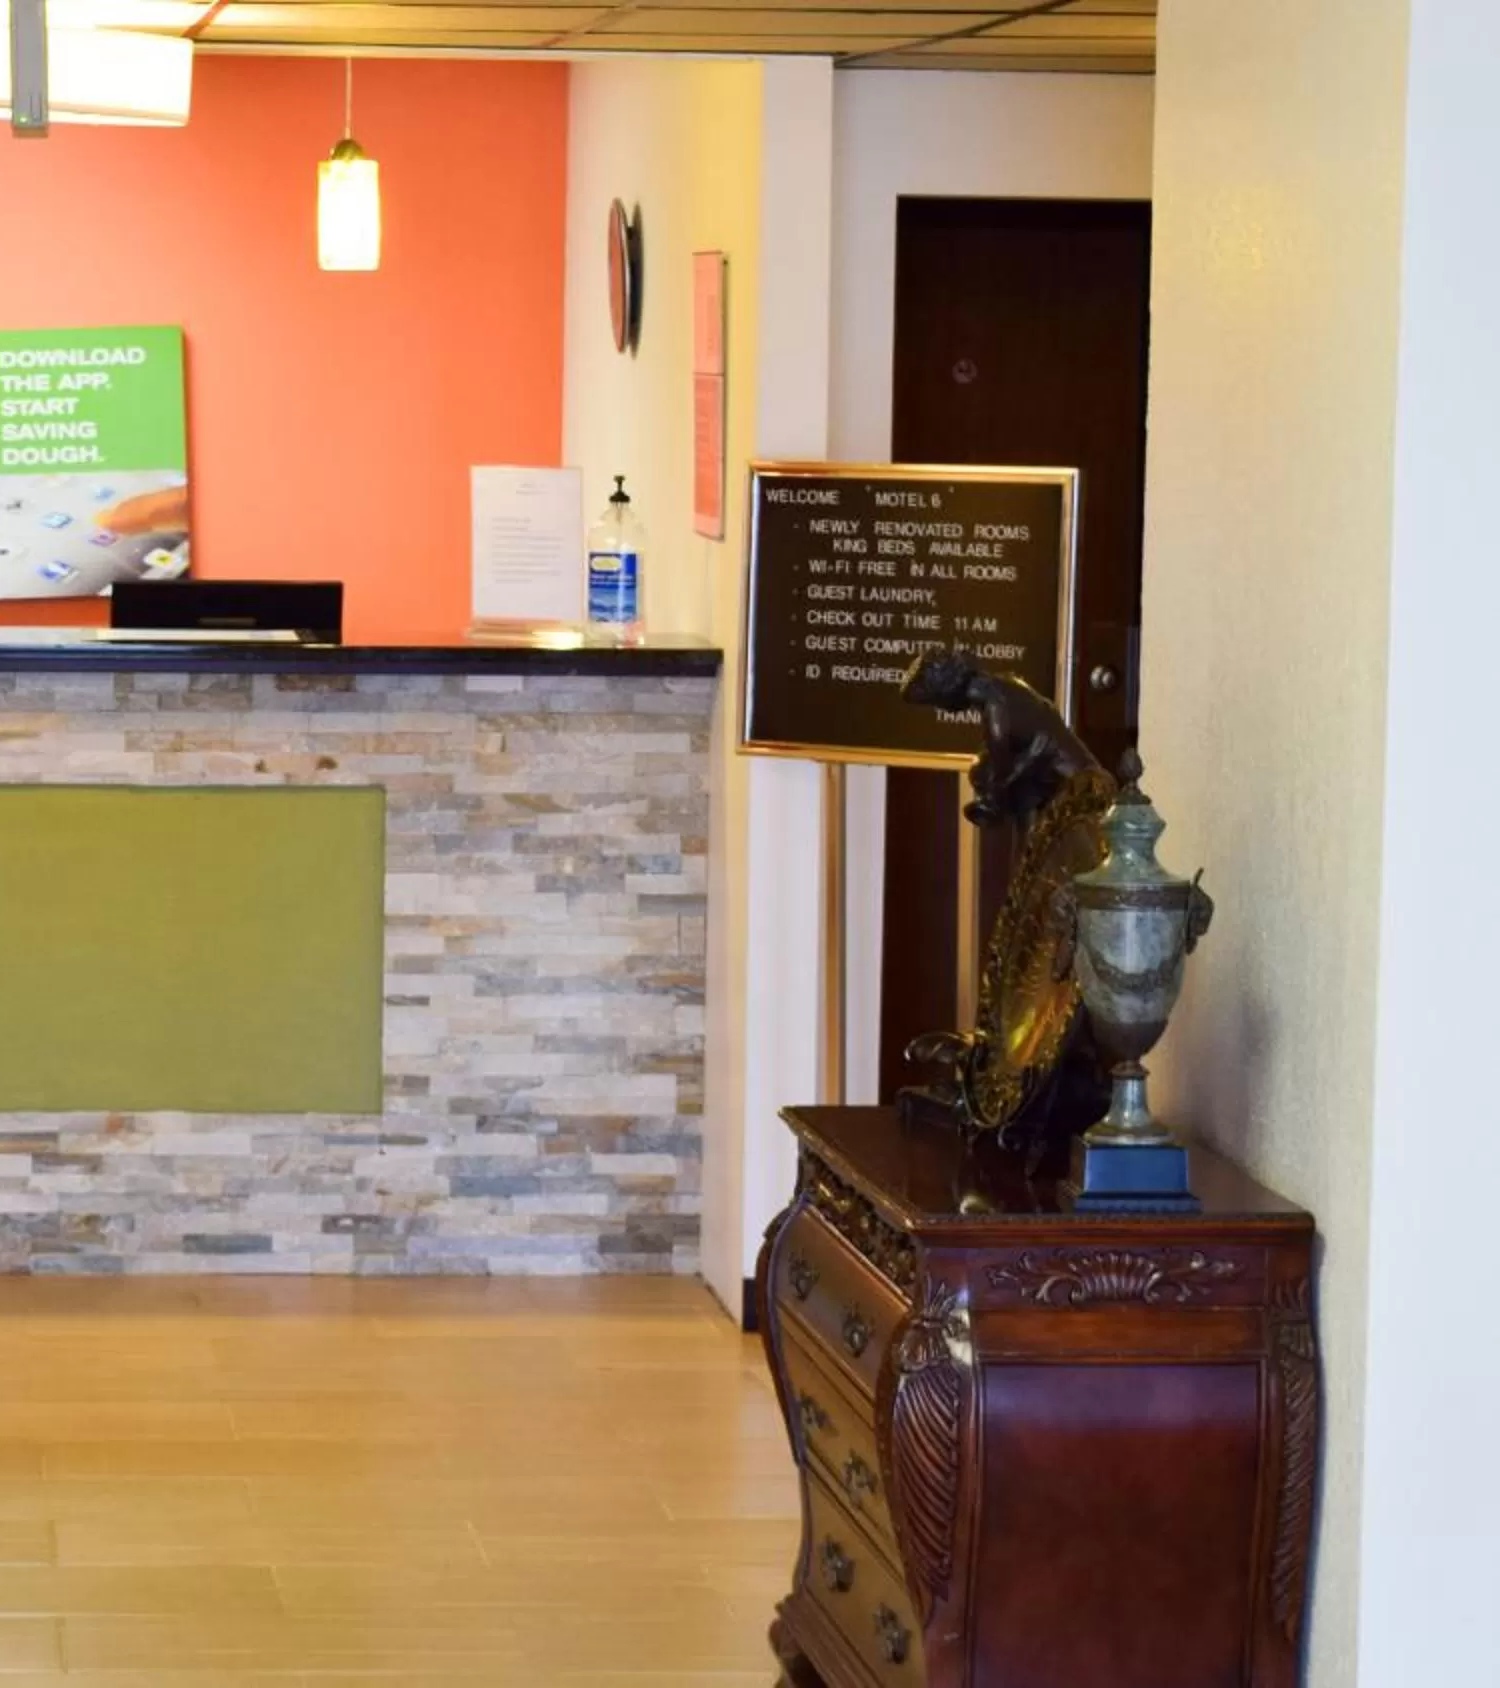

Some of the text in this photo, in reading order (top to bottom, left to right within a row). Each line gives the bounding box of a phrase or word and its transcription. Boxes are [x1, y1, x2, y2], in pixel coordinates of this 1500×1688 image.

[0, 372, 113, 393] THE APP.
[0, 397, 79, 417] START
[1, 421, 98, 441] SAVING
[2, 445, 105, 466] DOUGH.
[765, 487, 840, 506] WELCOME
[875, 491, 927, 508] MOTEL
[809, 518, 1030, 542] NEWLY RENOVATED ROOMS
[833, 537, 1004, 559] KING BEDS AVAILABLE
[808, 559, 851, 575] WI-FI
[858, 560, 897, 577] FREE
[930, 562, 958, 579] ALL
[963, 564, 1018, 582] ROOMS
[807, 584, 854, 601] GUEST
[806, 609, 856, 626] CHECK
[861, 611, 894, 628] OUT
[954, 615, 969, 631] 11
[971, 616, 998, 633] AM
[805, 634, 857, 652] GUEST
[975, 643, 1026, 661] LOBBY
[805, 662, 822, 679] ID
[934, 707, 982, 724] THAN
